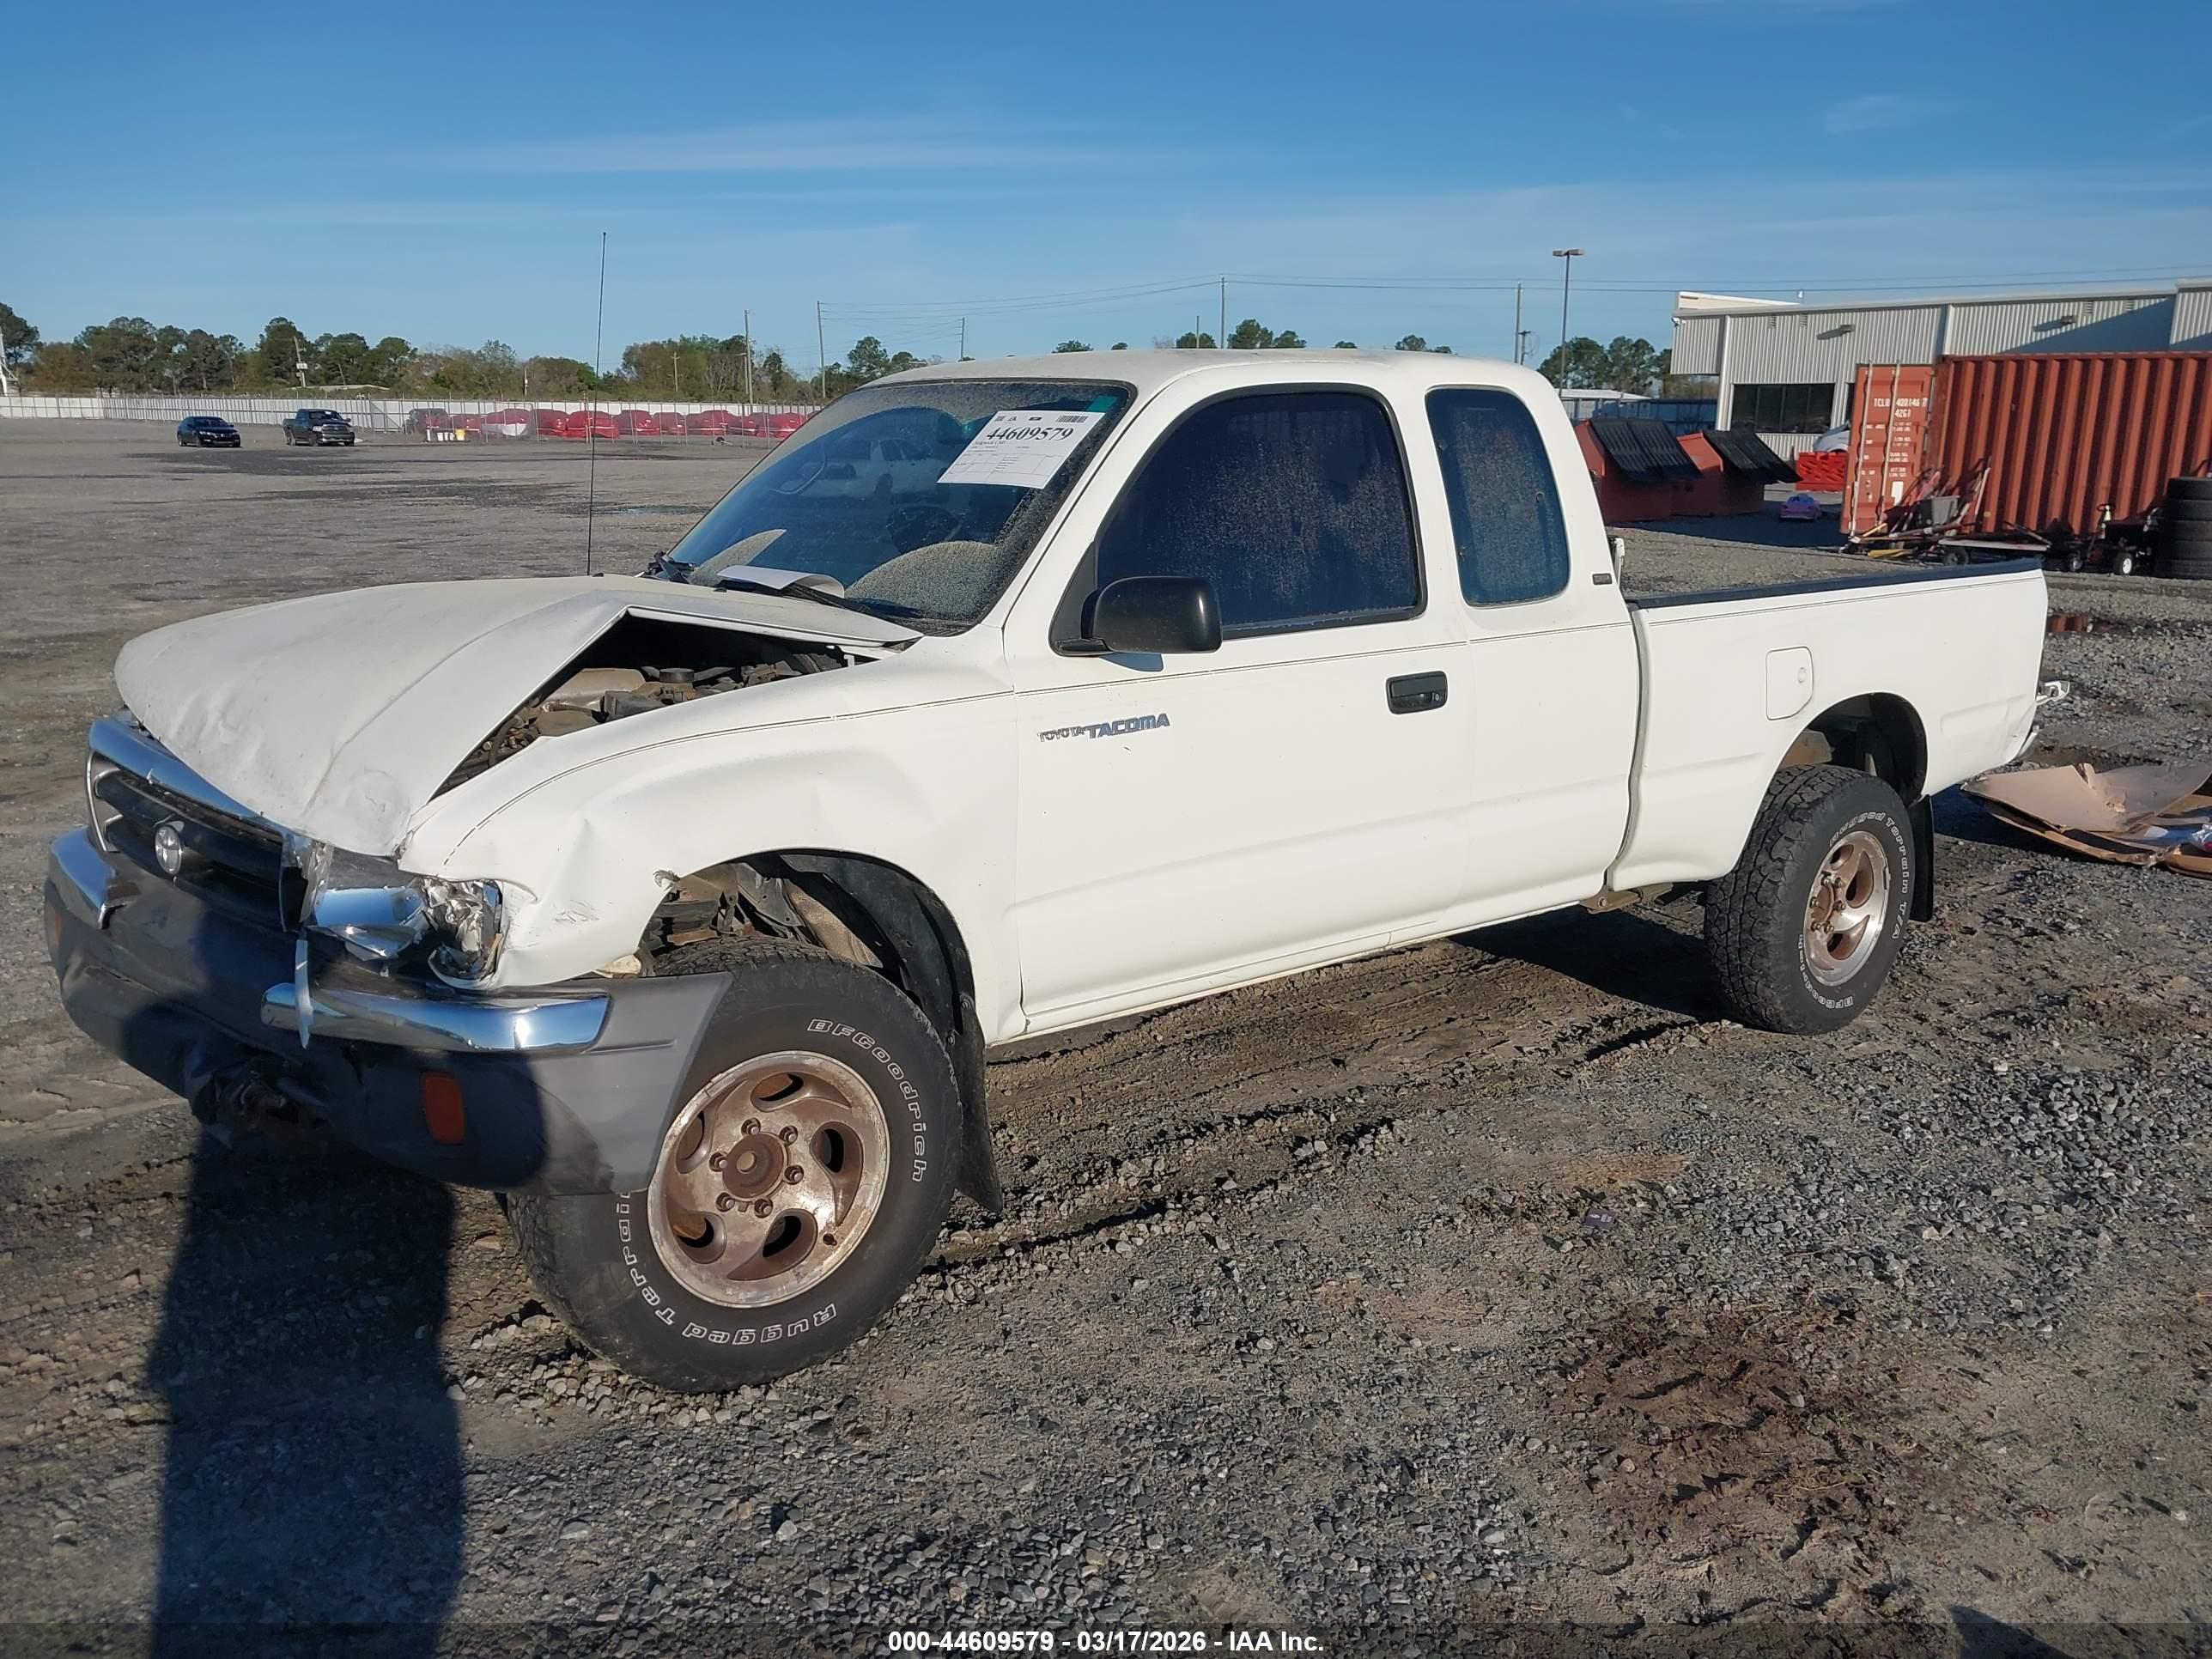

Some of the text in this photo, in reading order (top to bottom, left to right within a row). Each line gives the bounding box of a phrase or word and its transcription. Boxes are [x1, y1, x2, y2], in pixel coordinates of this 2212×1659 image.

[986, 427, 1074, 441] 44609579
[1037, 713, 1170, 743] TOYOTA TACOMA
[807, 1018, 927, 1182] BFGoodrich
[683, 1303, 837, 1346] Rugged
